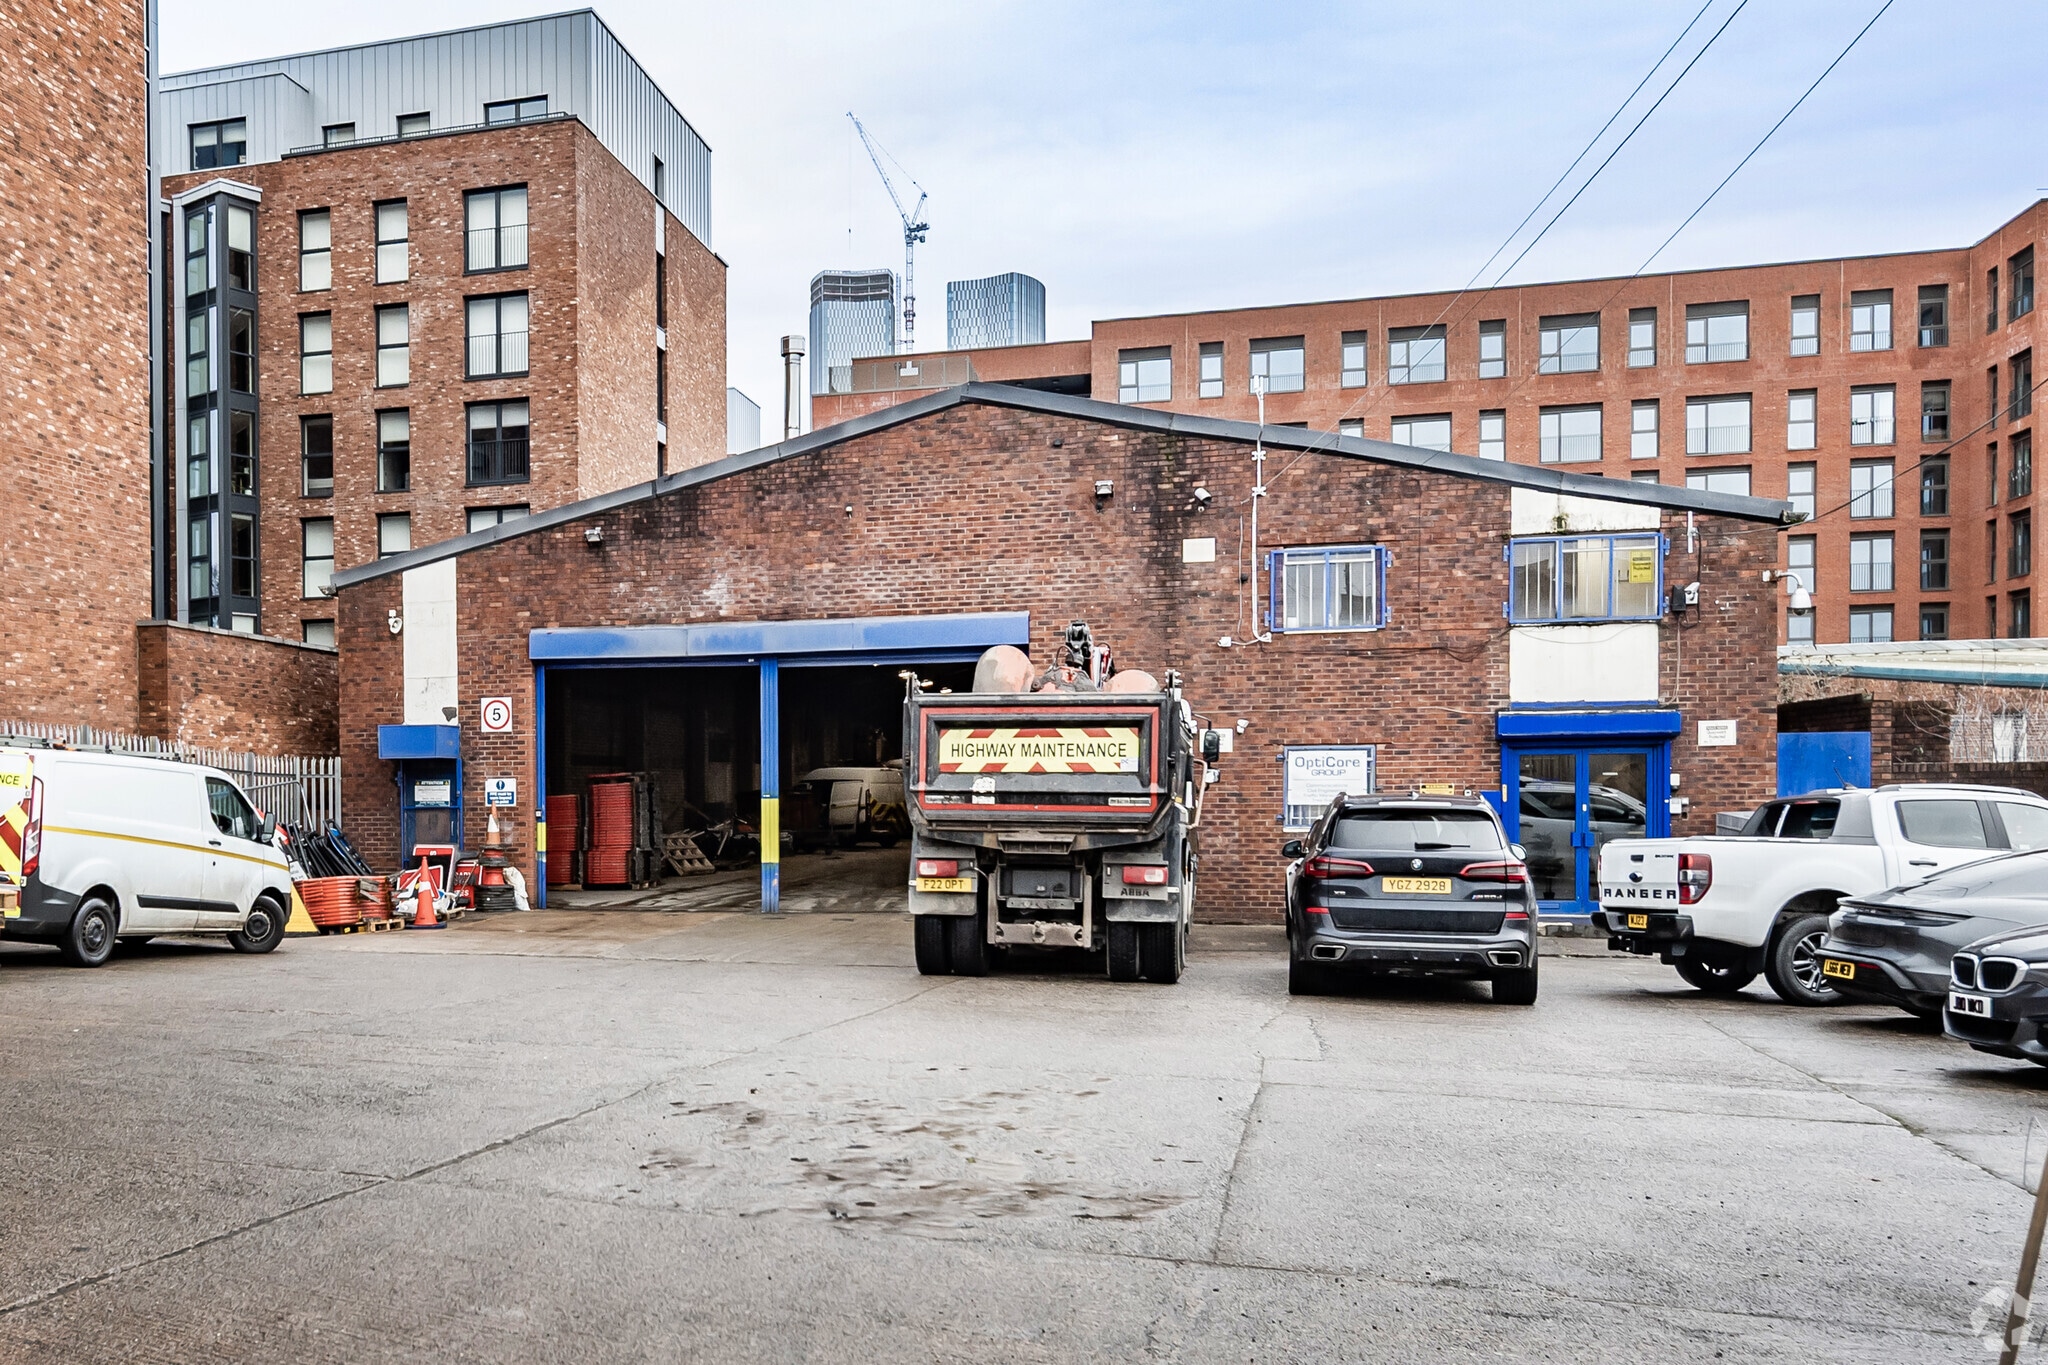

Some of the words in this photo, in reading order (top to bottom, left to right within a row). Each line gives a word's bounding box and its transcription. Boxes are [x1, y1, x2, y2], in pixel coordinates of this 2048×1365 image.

[492, 707, 501, 721] 5
[951, 743, 1016, 758] HIGHWAY
[1020, 743, 1127, 758] MAINTENANCE
[1295, 756, 1360, 770] OptiCore
[923, 879, 942, 889] F22
[1389, 879, 1412, 890] YGZ
[1416, 880, 1446, 891] 2928
[1603, 888, 1677, 899] RANGER
